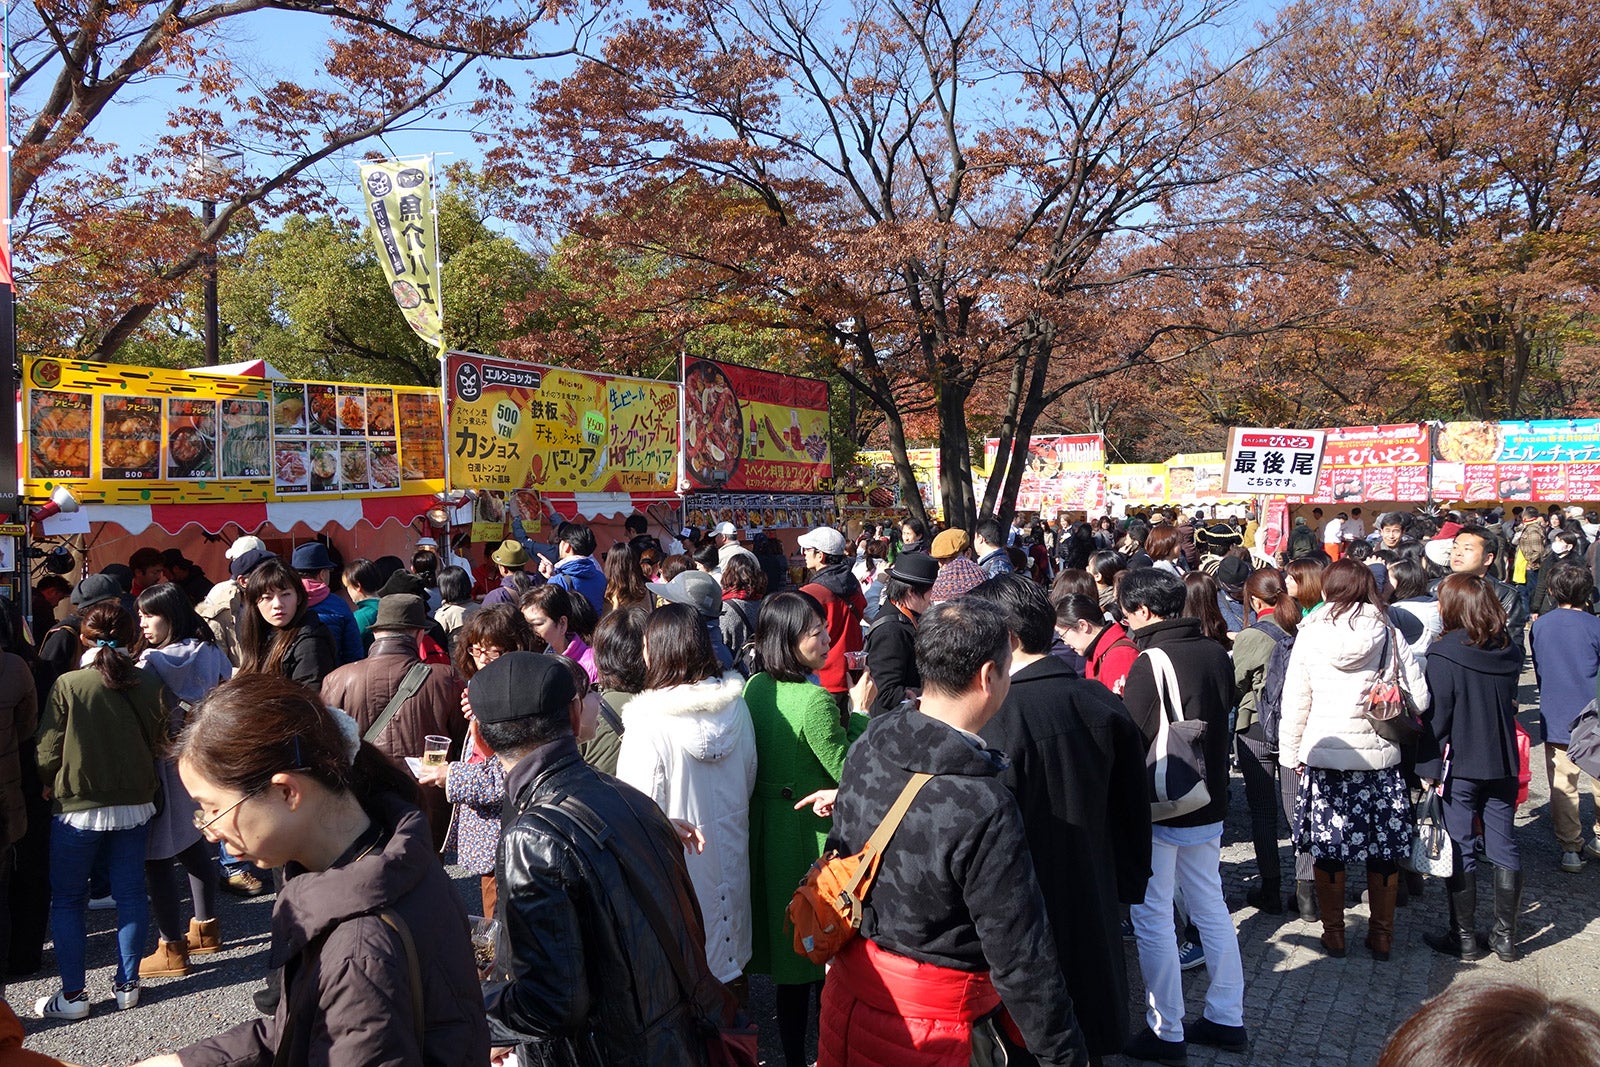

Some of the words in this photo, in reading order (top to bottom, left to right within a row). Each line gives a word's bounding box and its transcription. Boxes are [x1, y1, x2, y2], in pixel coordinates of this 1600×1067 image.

[485, 368, 540, 385] エルショッカー
[273, 386, 304, 394] オムレツ
[609, 386, 646, 412] 生ビール
[456, 407, 487, 417] スペイン風
[497, 404, 518, 425] 500
[531, 400, 558, 421] 鉄板
[456, 416, 487, 426] もつ煮込み
[631, 409, 677, 445] ハイボール
[498, 423, 513, 439] YEN
[587, 431, 600, 446] YEN
[609, 424, 656, 451] サングリア
[455, 426, 520, 460] カジョス
[1269, 435, 1310, 449] びいどろ
[609, 444, 629, 467] HOT
[627, 448, 673, 470] サングリア
[1055, 440, 1102, 463] SANGRÍA
[1347, 446, 1420, 465] びいどろ
[1502, 444, 1600, 462] エル・チャテ
[467, 463, 507, 473] 白濁トンコツ
[544, 448, 596, 475] パエリア
[1234, 450, 1315, 475] 最後尾
[53, 469, 71, 477] 500
[1247, 477, 1297, 488] こちらです。
